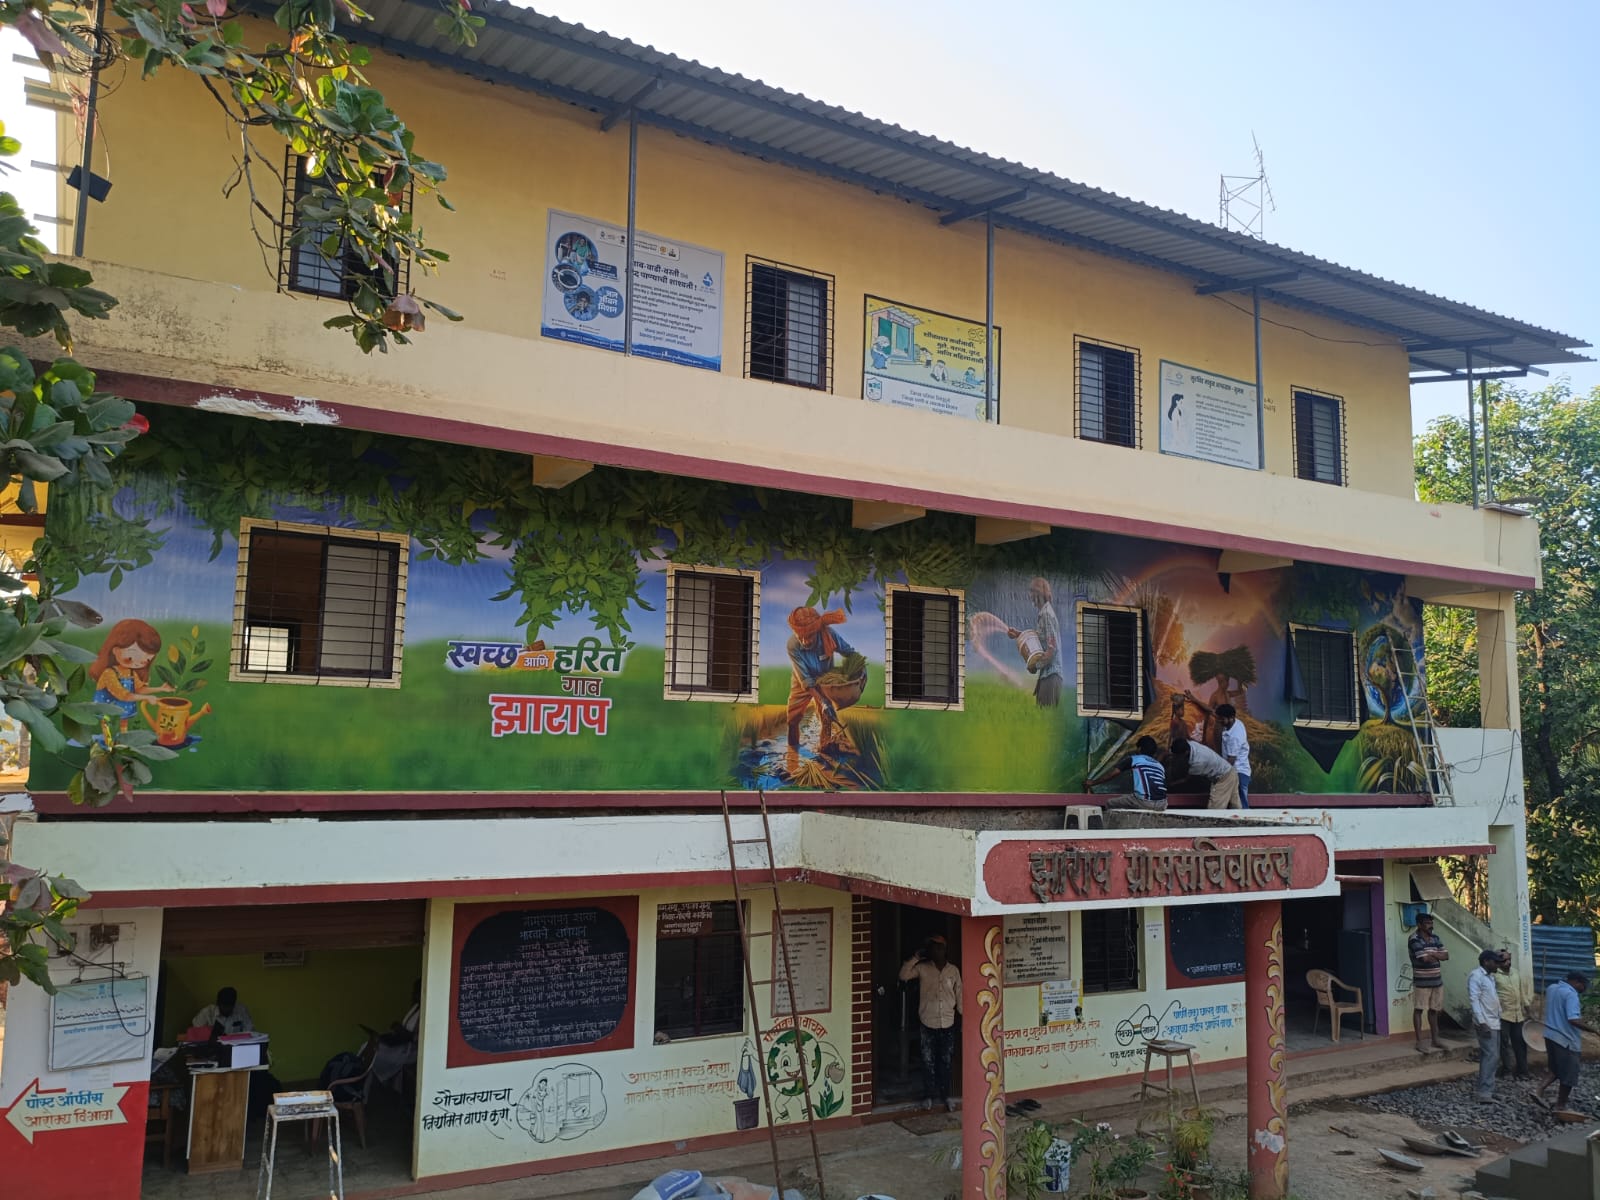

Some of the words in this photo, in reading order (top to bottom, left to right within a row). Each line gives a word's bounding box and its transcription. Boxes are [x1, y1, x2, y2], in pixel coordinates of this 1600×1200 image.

[448, 640, 523, 669] स्वच्छ
[523, 655, 550, 669] आणि
[553, 636, 627, 674] हरित
[561, 675, 602, 696] गाव
[489, 694, 612, 737] झाराप
[1029, 847, 1112, 903] झाराप
[1124, 837, 1293, 893] ग्रामसचिवालय
[25, 1092, 56, 1111] पोस्ट
[422, 1113, 463, 1131] नियमित
[464, 1110, 488, 1126] वापर
